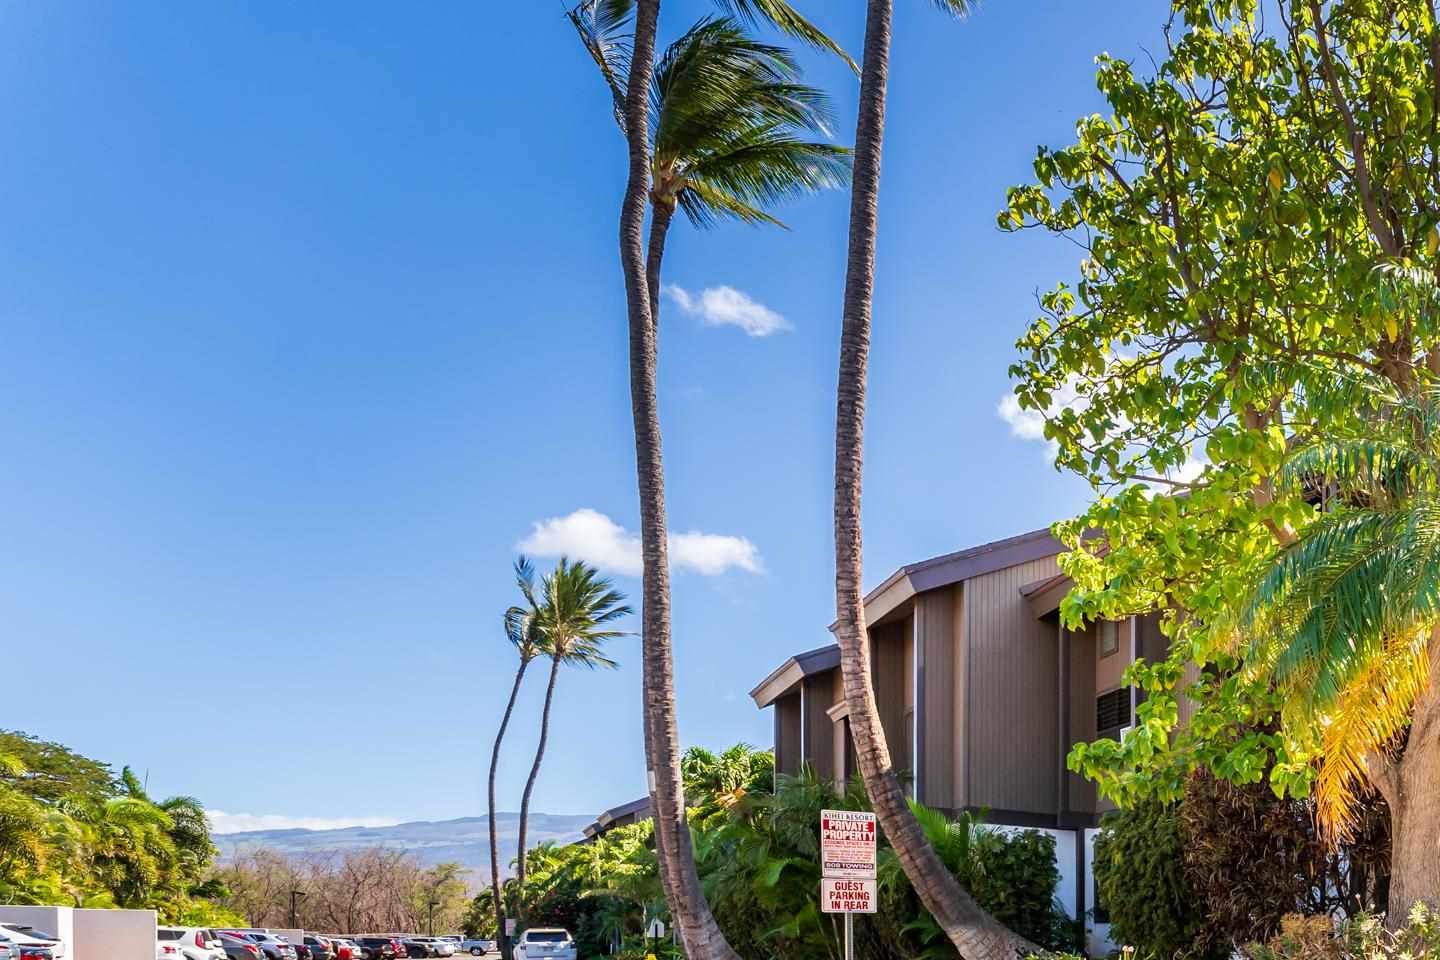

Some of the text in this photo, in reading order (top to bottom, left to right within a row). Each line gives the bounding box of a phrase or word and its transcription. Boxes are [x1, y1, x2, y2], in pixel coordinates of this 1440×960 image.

[829, 820, 869, 831] PRIVATE
[824, 830, 874, 840] PROPERTY
[835, 881, 864, 891] GUEST
[829, 891, 870, 900] PARKING
[831, 900, 868, 909] IN REAR
